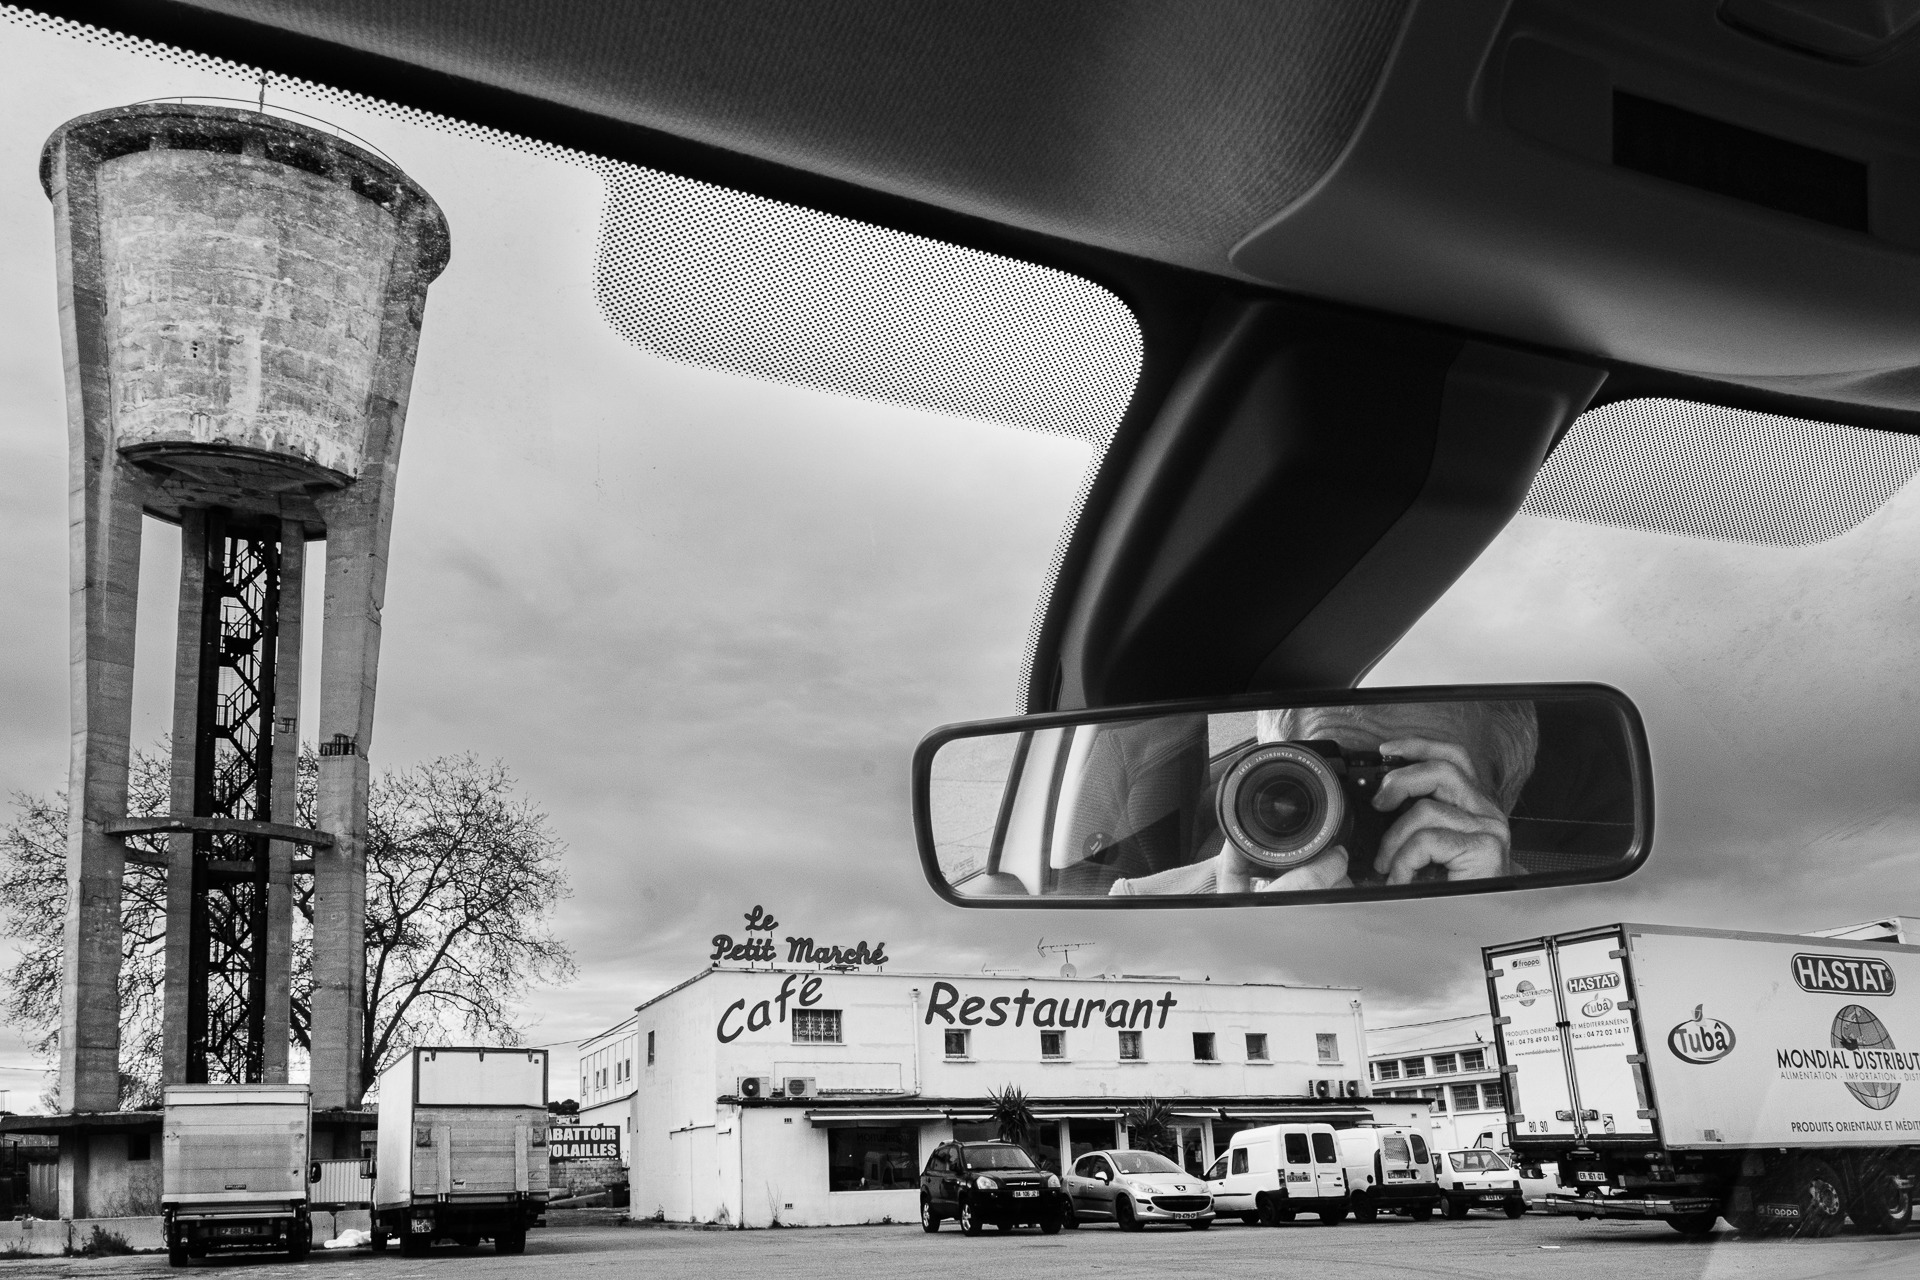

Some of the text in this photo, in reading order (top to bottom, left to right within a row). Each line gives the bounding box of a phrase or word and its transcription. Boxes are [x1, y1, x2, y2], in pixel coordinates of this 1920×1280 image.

[744, 905, 779, 931] Le
[710, 934, 889, 965] Petit Marché
[1568, 973, 1617, 992] HASTAT
[1796, 958, 1887, 991] HASTAT
[1500, 988, 1553, 1000] MONDIAL DISTRIBUTION
[717, 973, 823, 1044] Café
[924, 981, 1178, 1030] Restaurant
[1586, 998, 1610, 1014] Tubâ
[1505, 1029, 1530, 1037] PRODUITS
[1530, 1025, 1559, 1035] ORIENTAUX
[1587, 1030, 1595, 1038] 04
[1675, 1022, 1728, 1053] Tubâ
[1776, 1048, 1849, 1069] MONDIAL
[1780, 1071, 1838, 1080] ALIMENTATION
[1846, 1072, 1897, 1081] IMPORTATION
[1904, 1073, 1920, 1081] DIST
[1791, 1121, 1834, 1133] PRODUITS
[1835, 1121, 1883, 1132] ORIENTAUX
[1884, 1121, 1894, 1131] ET
